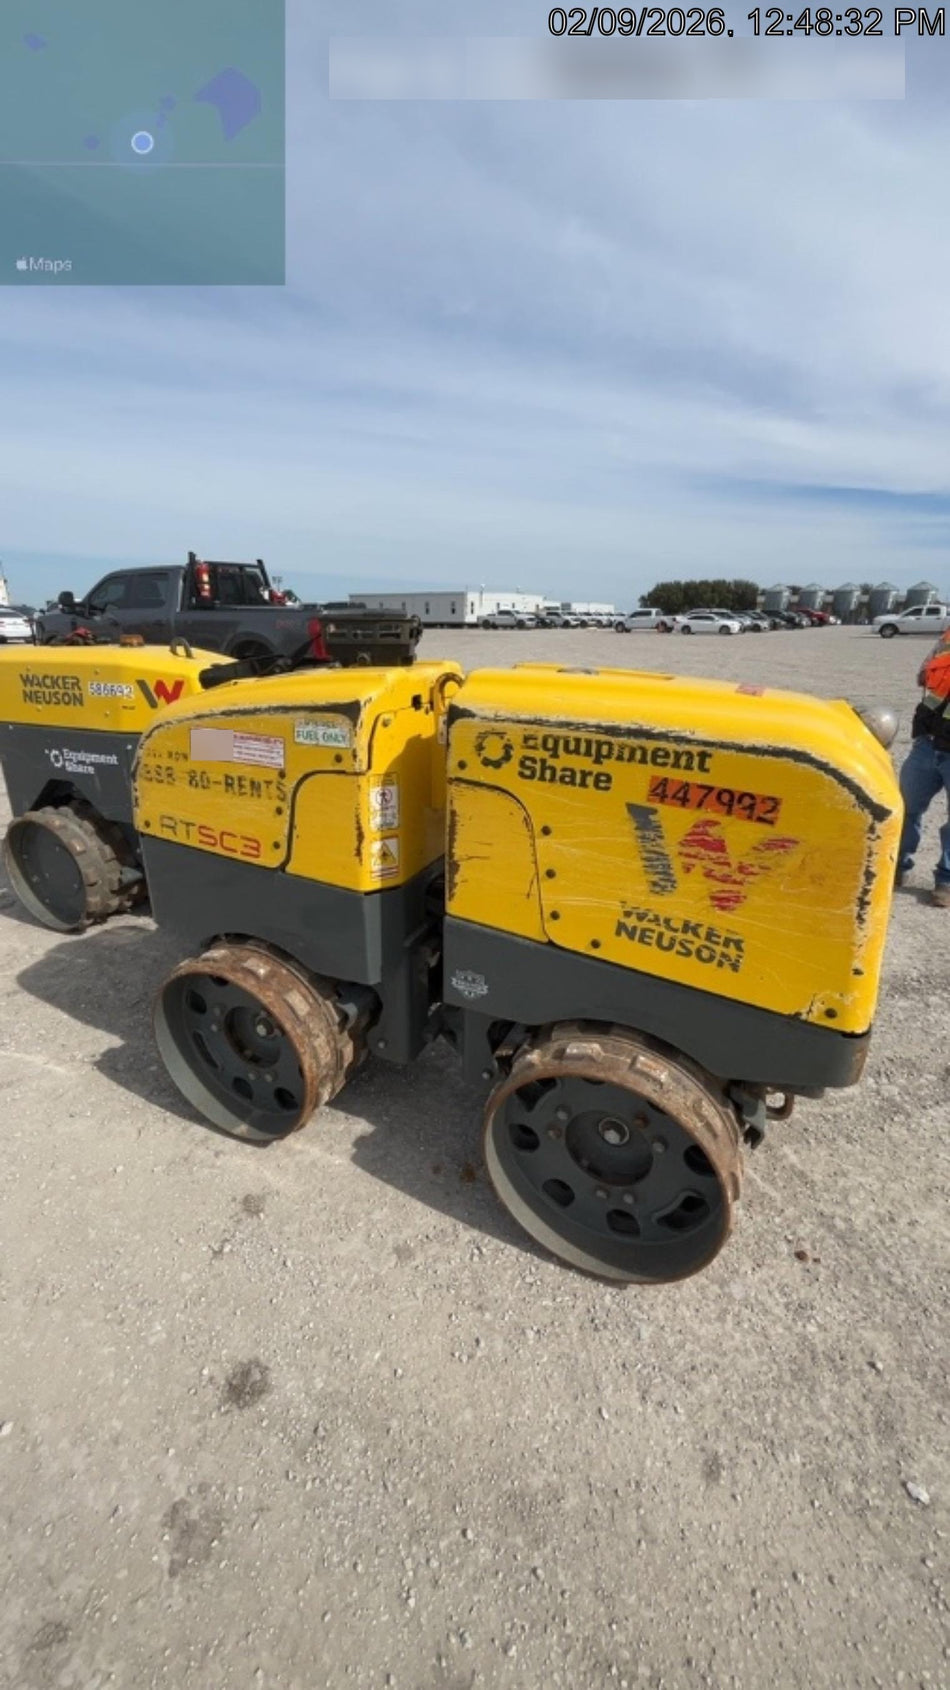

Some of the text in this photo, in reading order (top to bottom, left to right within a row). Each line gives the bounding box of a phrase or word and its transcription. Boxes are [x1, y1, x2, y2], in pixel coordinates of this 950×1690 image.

[19, 674, 82, 691] WACKER
[22, 689, 84, 707] NEUSON
[296, 729, 347, 744] FUEL ONLY
[63, 748, 119, 765] Equipment
[521, 733, 713, 774] Equipment
[65, 761, 95, 774] Share
[518, 755, 613, 791] Share
[650, 776, 779, 825] 447992
[619, 901, 744, 952] WACKER
[614, 919, 743, 973] NEUSON
